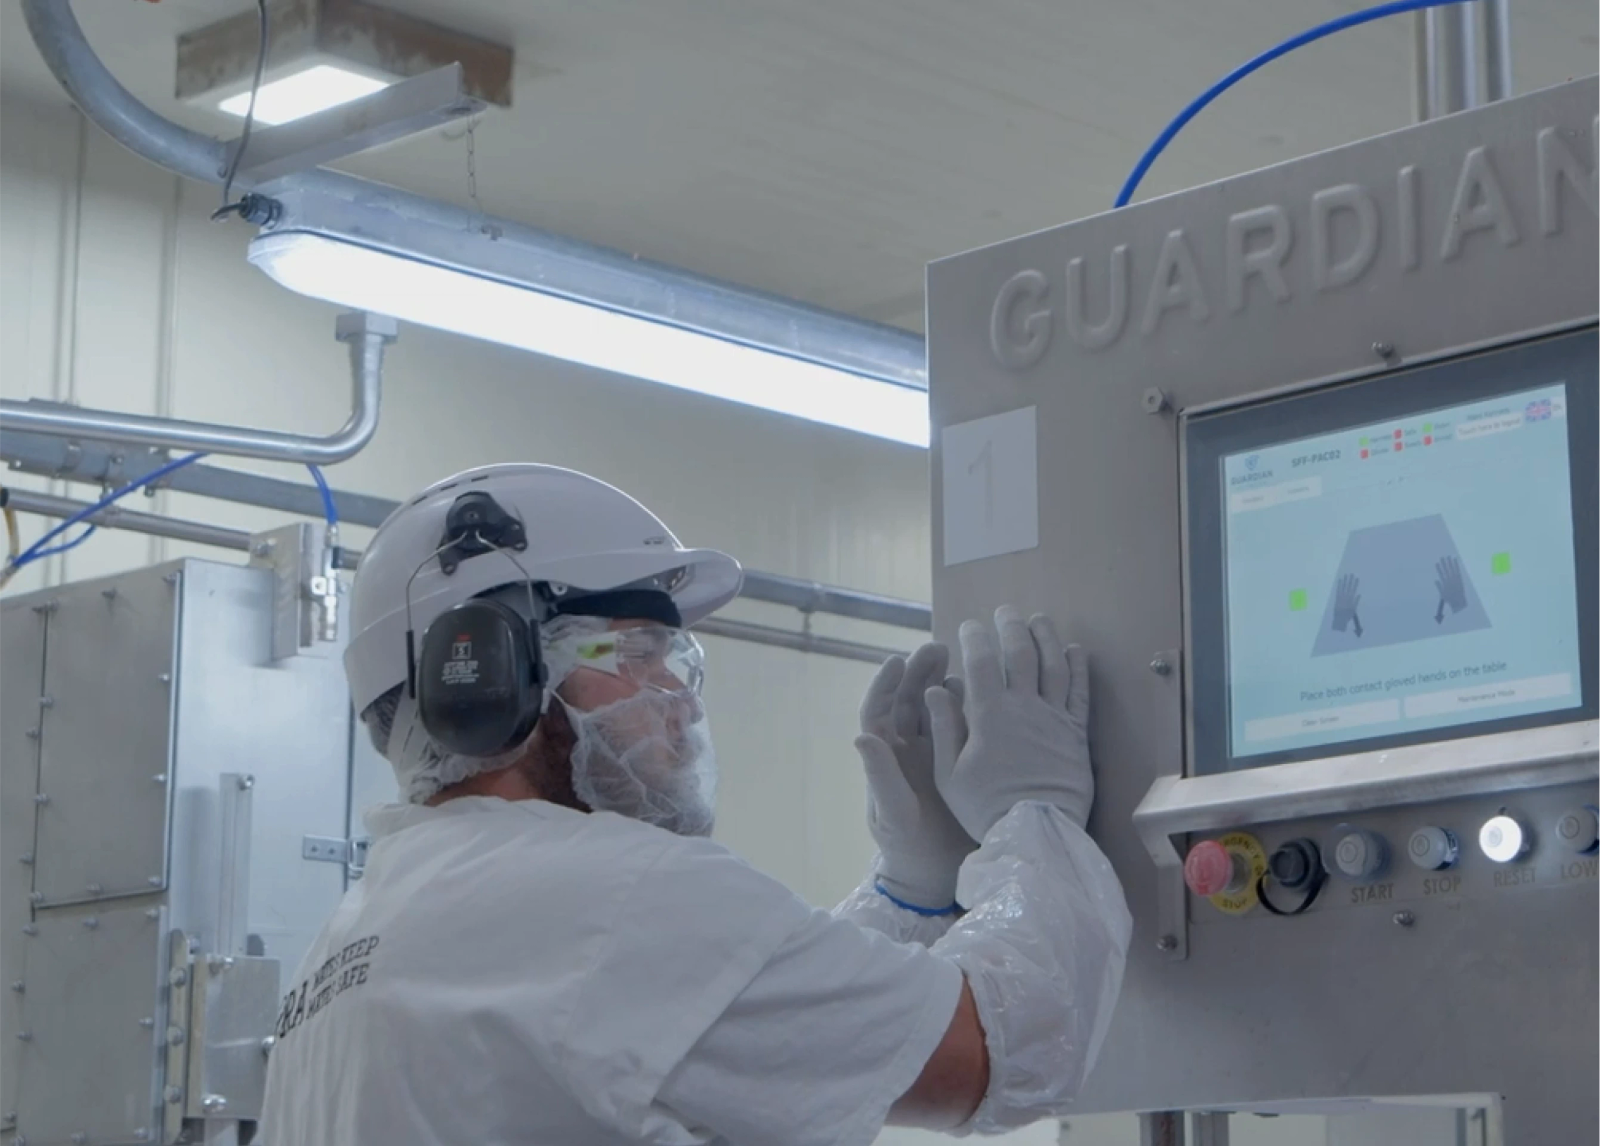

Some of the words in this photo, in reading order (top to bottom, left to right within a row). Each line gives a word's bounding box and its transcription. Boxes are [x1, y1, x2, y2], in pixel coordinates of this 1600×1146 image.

[988, 113, 1600, 371] GUARDIAN
[967, 438, 995, 525] 1
[1231, 470, 1274, 485] GUARDIAN
[1300, 689, 1324, 701] Place
[1326, 684, 1348, 698] both
[1349, 680, 1383, 695] contact
[1384, 674, 1416, 692] gloved
[1449, 669, 1461, 679] on
[1463, 664, 1480, 676] the
[1482, 660, 1507, 674] table
[1423, 876, 1462, 896] STOP
[1494, 867, 1536, 887] RESET
[1351, 882, 1394, 904] START
